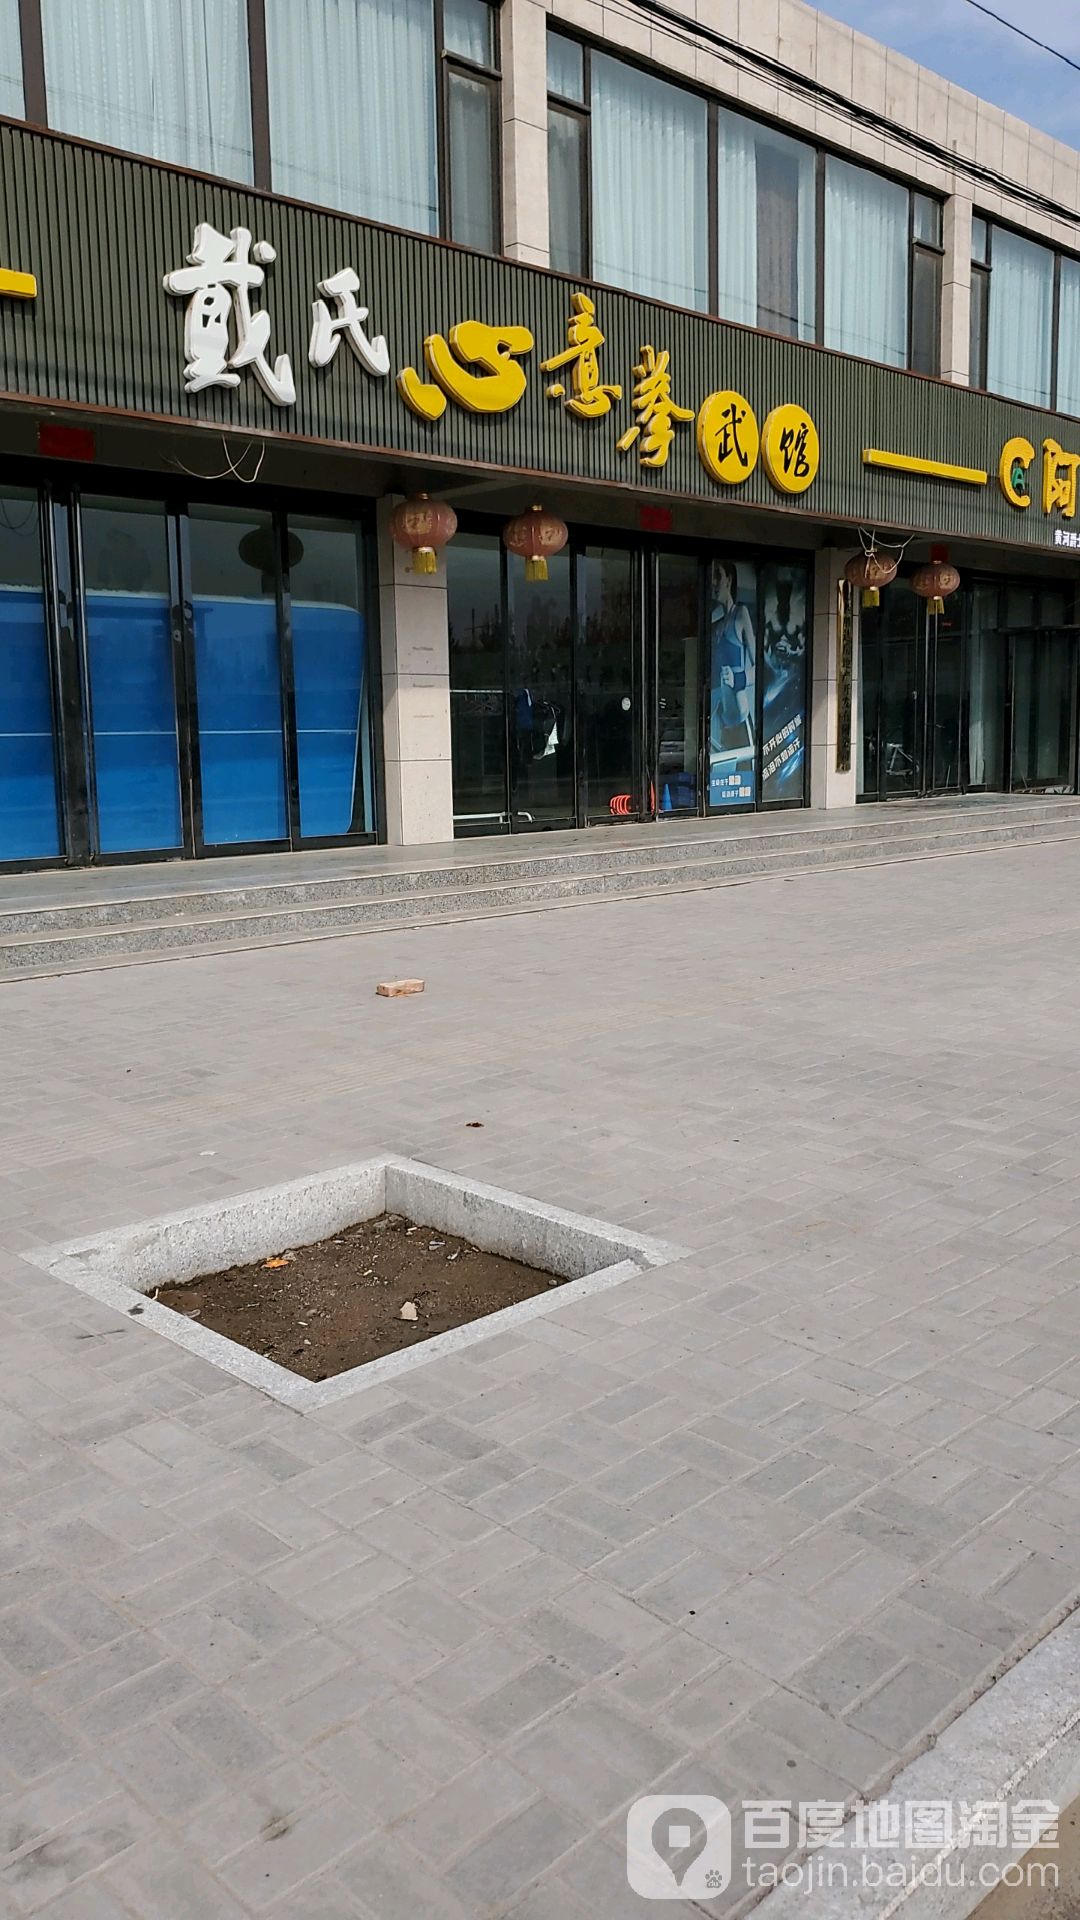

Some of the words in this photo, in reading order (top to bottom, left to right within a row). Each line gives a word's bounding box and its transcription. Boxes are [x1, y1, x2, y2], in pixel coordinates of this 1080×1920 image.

[163, 222, 814, 482] 戴氏心意拳武馆
[1043, 438, 1080, 517] 阿
